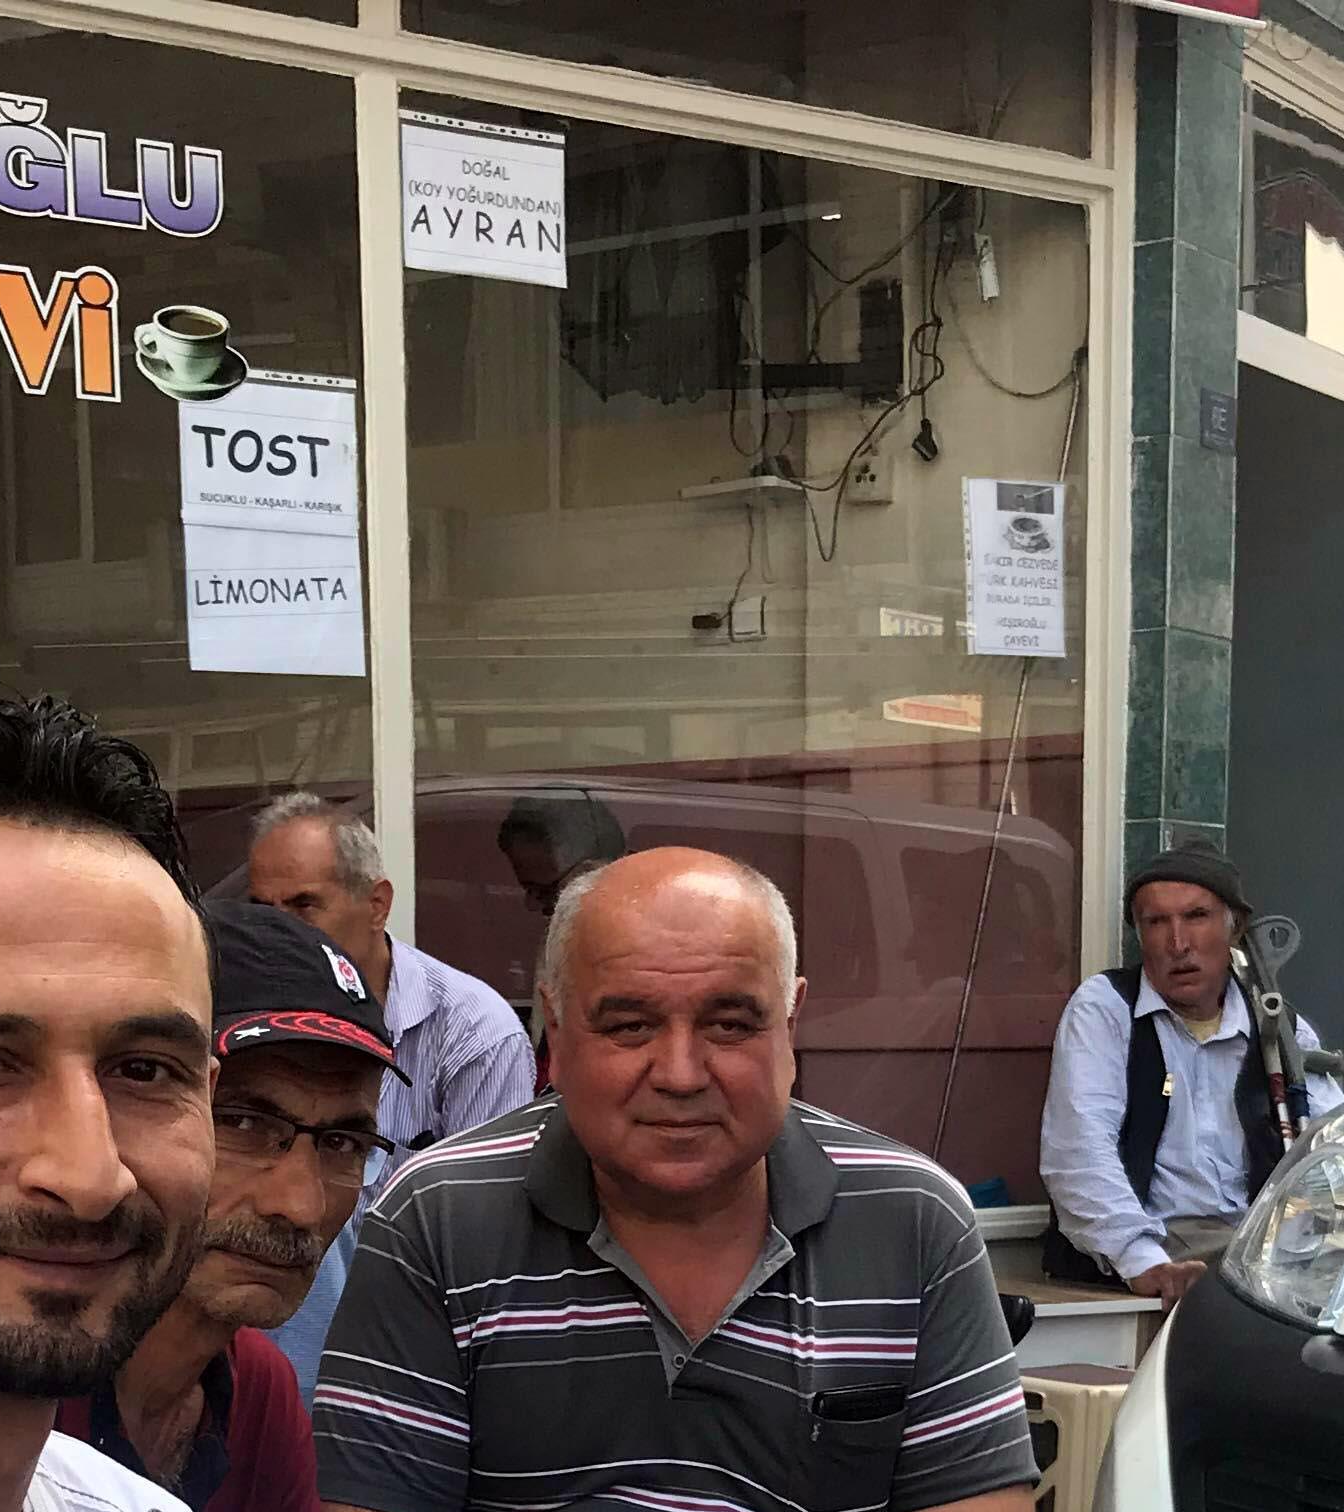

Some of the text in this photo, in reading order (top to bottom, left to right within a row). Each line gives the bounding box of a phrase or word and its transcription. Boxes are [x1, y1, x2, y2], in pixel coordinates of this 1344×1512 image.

[462, 160, 510, 181] DOĞAL
[410, 204, 561, 254] AYRAN
[191, 424, 330, 478] TOST
[199, 491, 248, 506] SUCUKLU
[194, 573, 348, 606] LİMONATA
